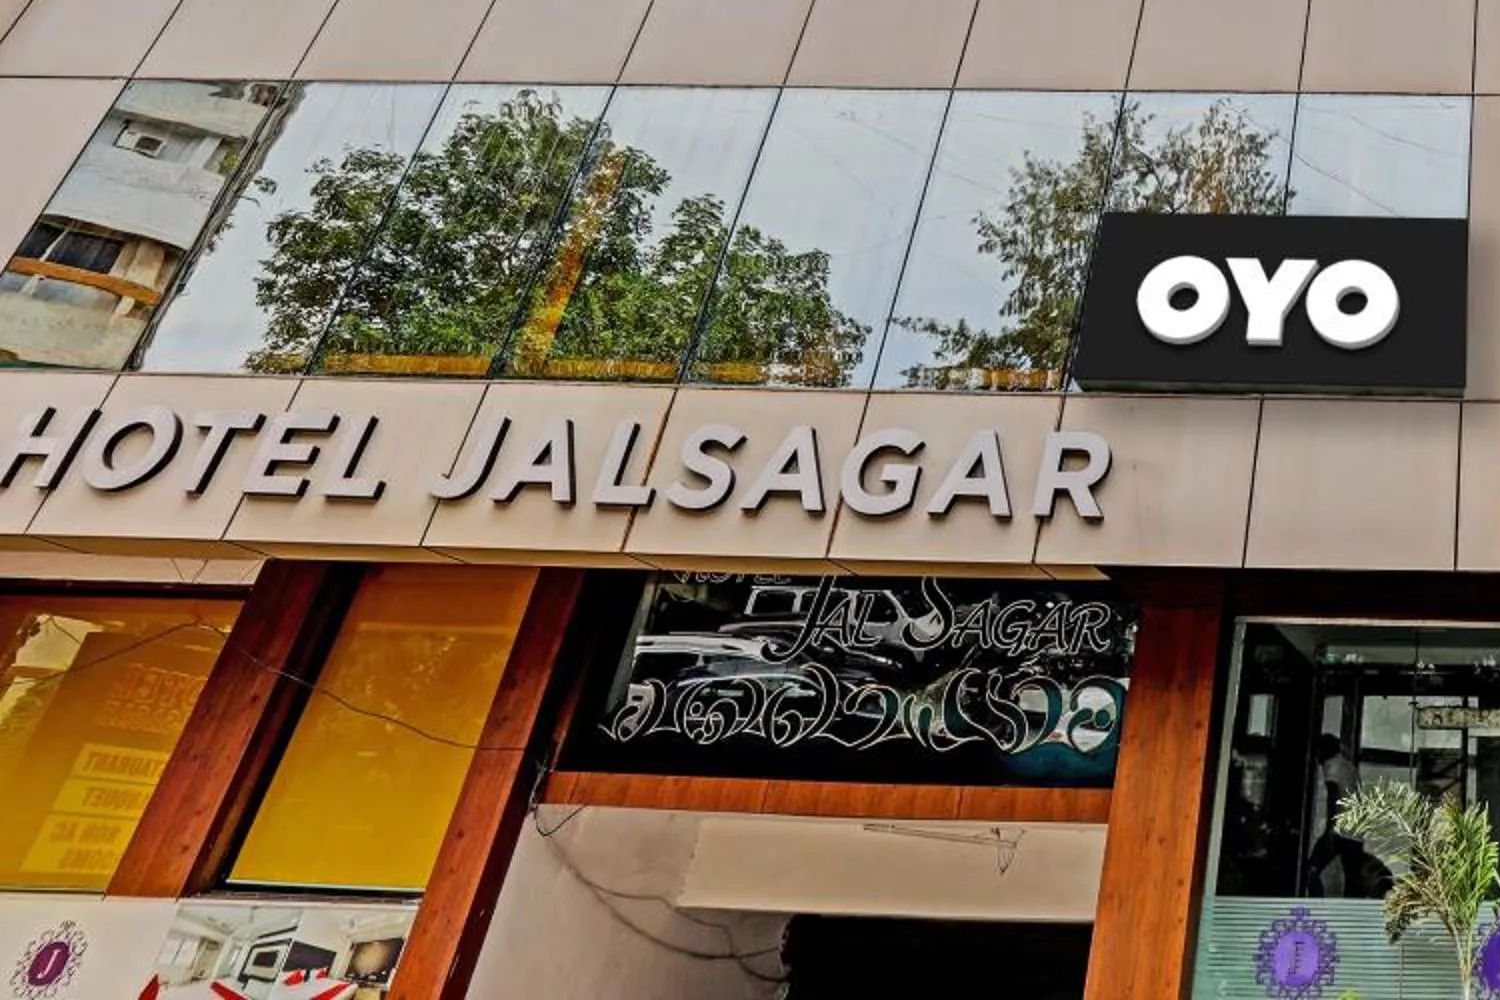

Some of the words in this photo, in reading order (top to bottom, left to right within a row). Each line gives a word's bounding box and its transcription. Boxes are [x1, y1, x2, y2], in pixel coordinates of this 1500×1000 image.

[1136, 254, 1400, 350] OYO
[0, 405, 387, 505] HOTEL
[427, 415, 1113, 520] JALSAGAR
[758, 574, 880, 664] JAL
[902, 576, 1112, 657] SAGAR
